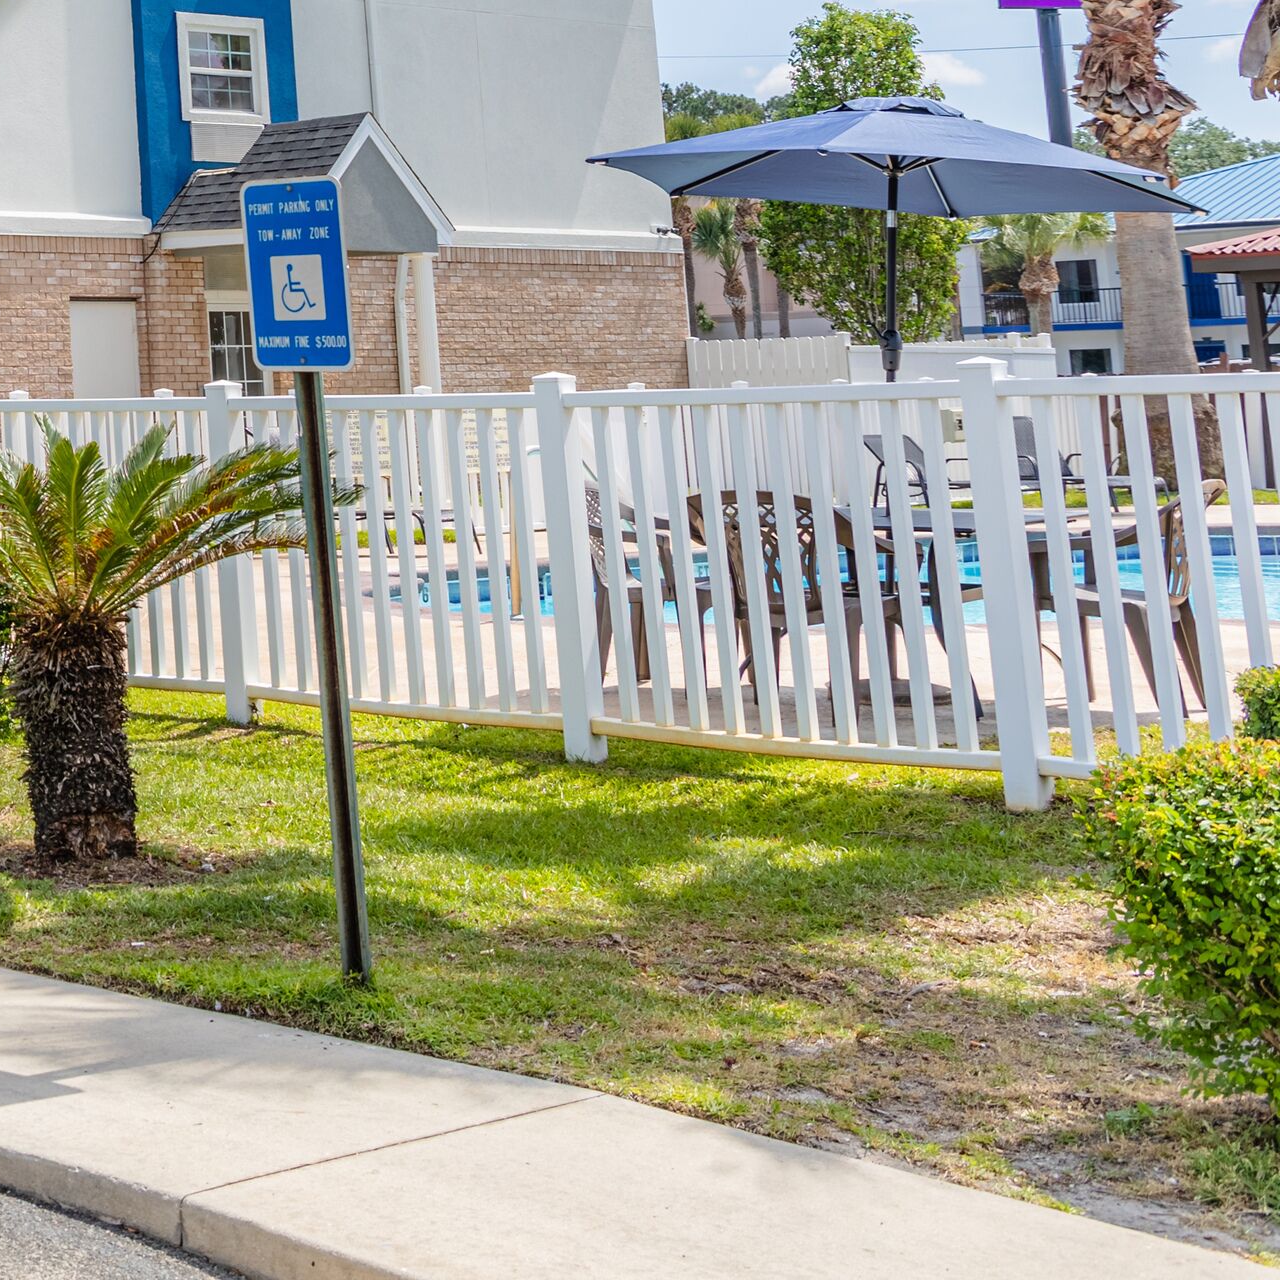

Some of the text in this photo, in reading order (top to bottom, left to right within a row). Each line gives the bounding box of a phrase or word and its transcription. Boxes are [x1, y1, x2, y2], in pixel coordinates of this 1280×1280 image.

[248, 198, 335, 216] PERMIT PARKING ONLY
[309, 226, 330, 239] ZONE
[258, 336, 291, 349] MAXIMUM
[295, 335, 310, 348] FINE
